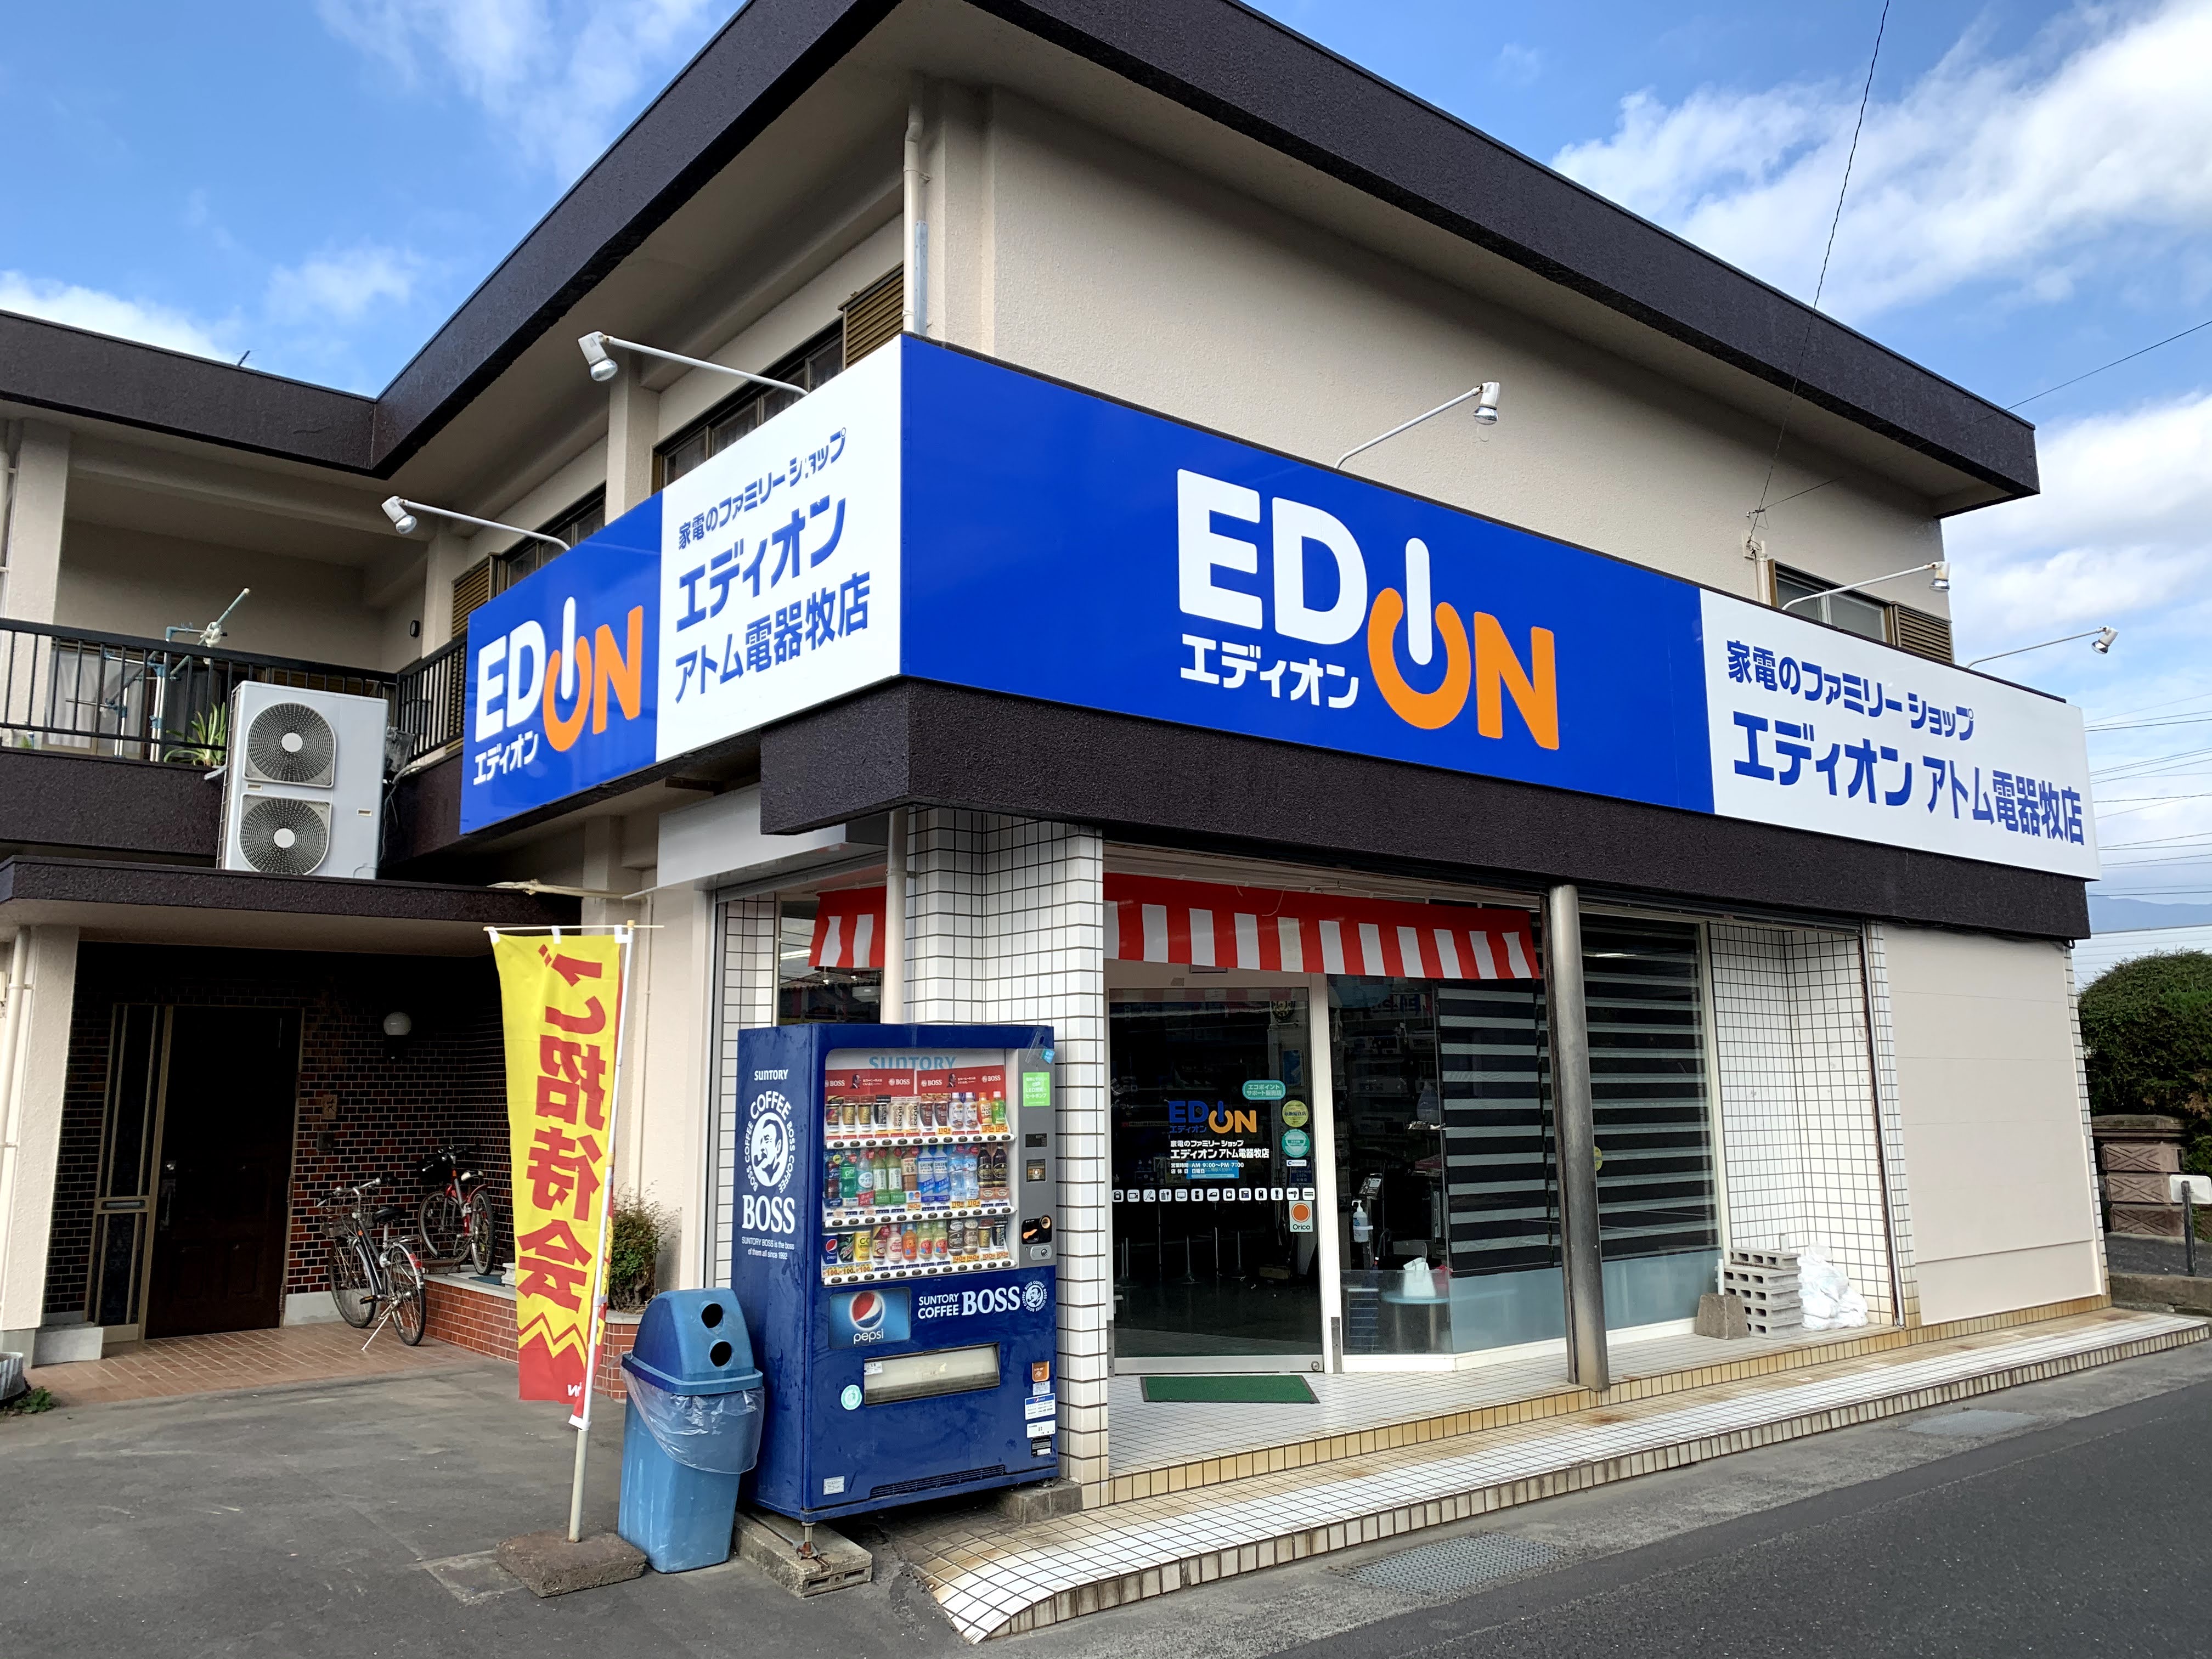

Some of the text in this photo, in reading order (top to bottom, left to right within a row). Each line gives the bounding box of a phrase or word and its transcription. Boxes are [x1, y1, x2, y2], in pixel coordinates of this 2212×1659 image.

[676, 495, 846, 632] エディオン
[1177, 469, 1560, 751] EDION
[675, 571, 870, 704] アトム電器牧店
[475, 596, 642, 752] EDION
[1180, 634, 1359, 709] エディオン
[473, 730, 538, 785] エディオン
[754, 1069, 788, 1081] SUNTORY
[750, 1091, 792, 1121] COFFEE
[1169, 1101, 1257, 1133] EDION
[1170, 1125, 1207, 1133] エディオン
[744, 1120, 758, 1192] BOSS COFFEE
[778, 1120, 795, 1194] BOSS COFFEE
[742, 1194, 795, 1234] BOSS
[742, 1237, 761, 1246] SUNTORY
[761, 1239, 774, 1248] BOSS
[785, 1241, 795, 1250] boss
[752, 1248, 761, 1256] them
[768, 1250, 778, 1259] since
[778, 1251, 788, 1260] 1992
[918, 1293, 959, 1306] SUNTORY
[918, 1304, 959, 1319] COFFEE
[961, 1286, 1020, 1316] BOSS
[853, 1328, 884, 1345] pepsi
